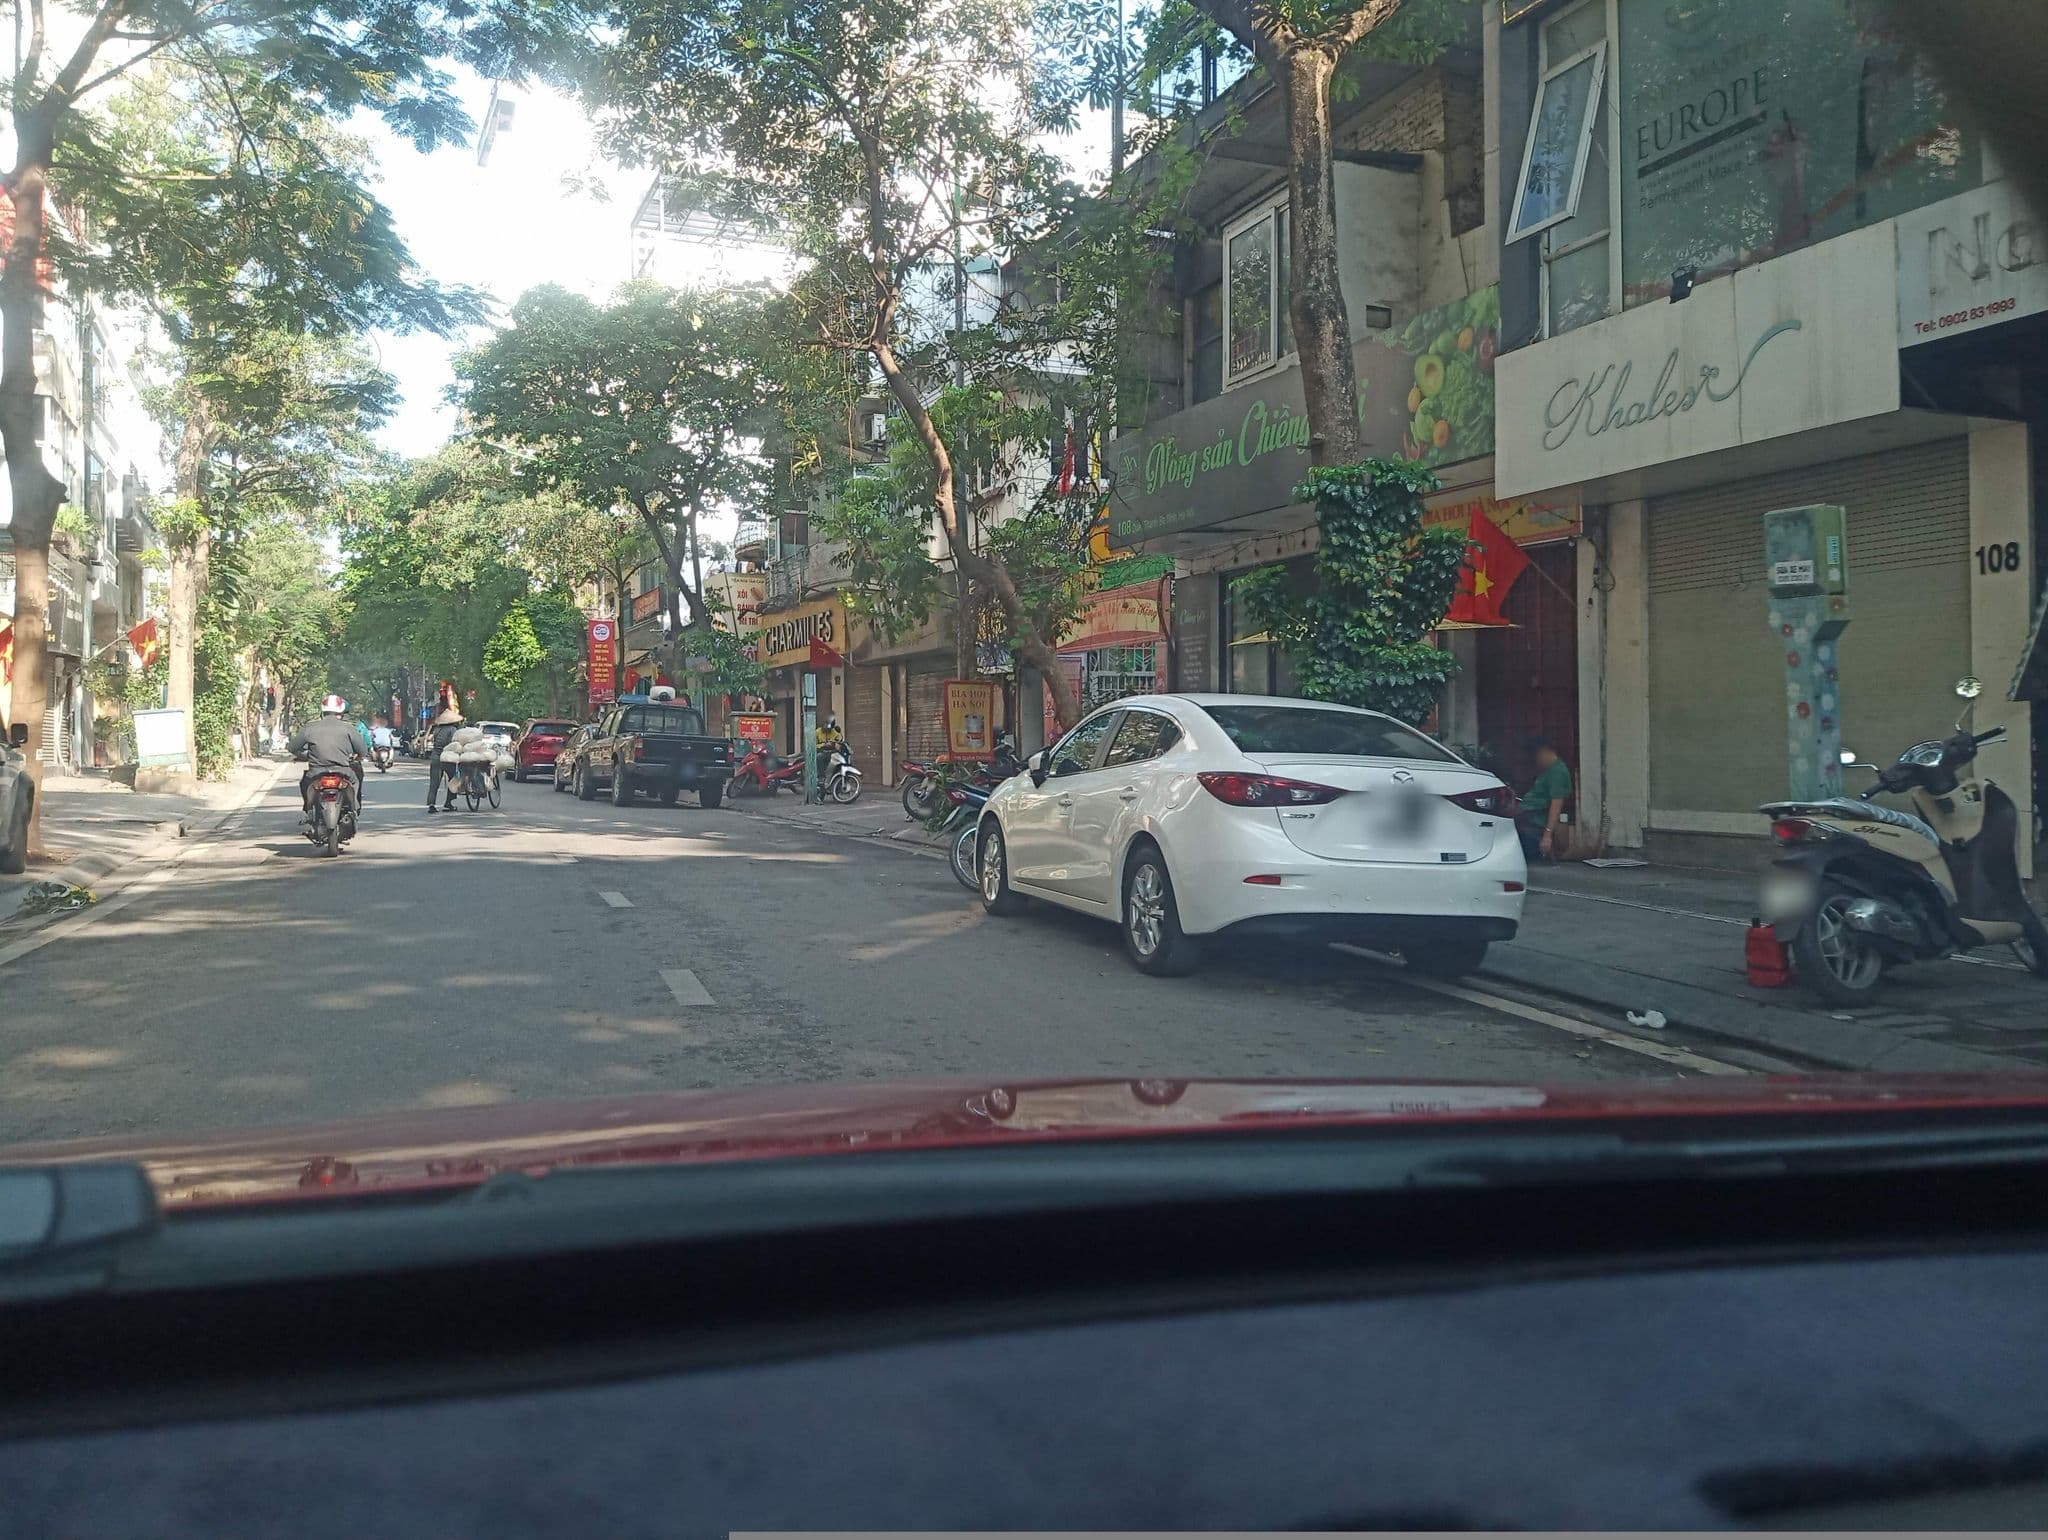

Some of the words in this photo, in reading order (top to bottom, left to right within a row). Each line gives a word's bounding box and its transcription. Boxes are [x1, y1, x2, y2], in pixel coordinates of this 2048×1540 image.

[1637, 65, 1768, 161] EUROPE
[1914, 321, 1937, 334] Tel:
[1938, 311, 1968, 328] 0902
[1969, 306, 1984, 320] 83
[1985, 297, 2016, 315] 1993
[1201, 429, 1233, 473] sản
[1118, 520, 1131, 536] 108
[1975, 541, 2020, 575] 108
[765, 609, 832, 656] CHARMILLES
[951, 689, 967, 698] BIA
